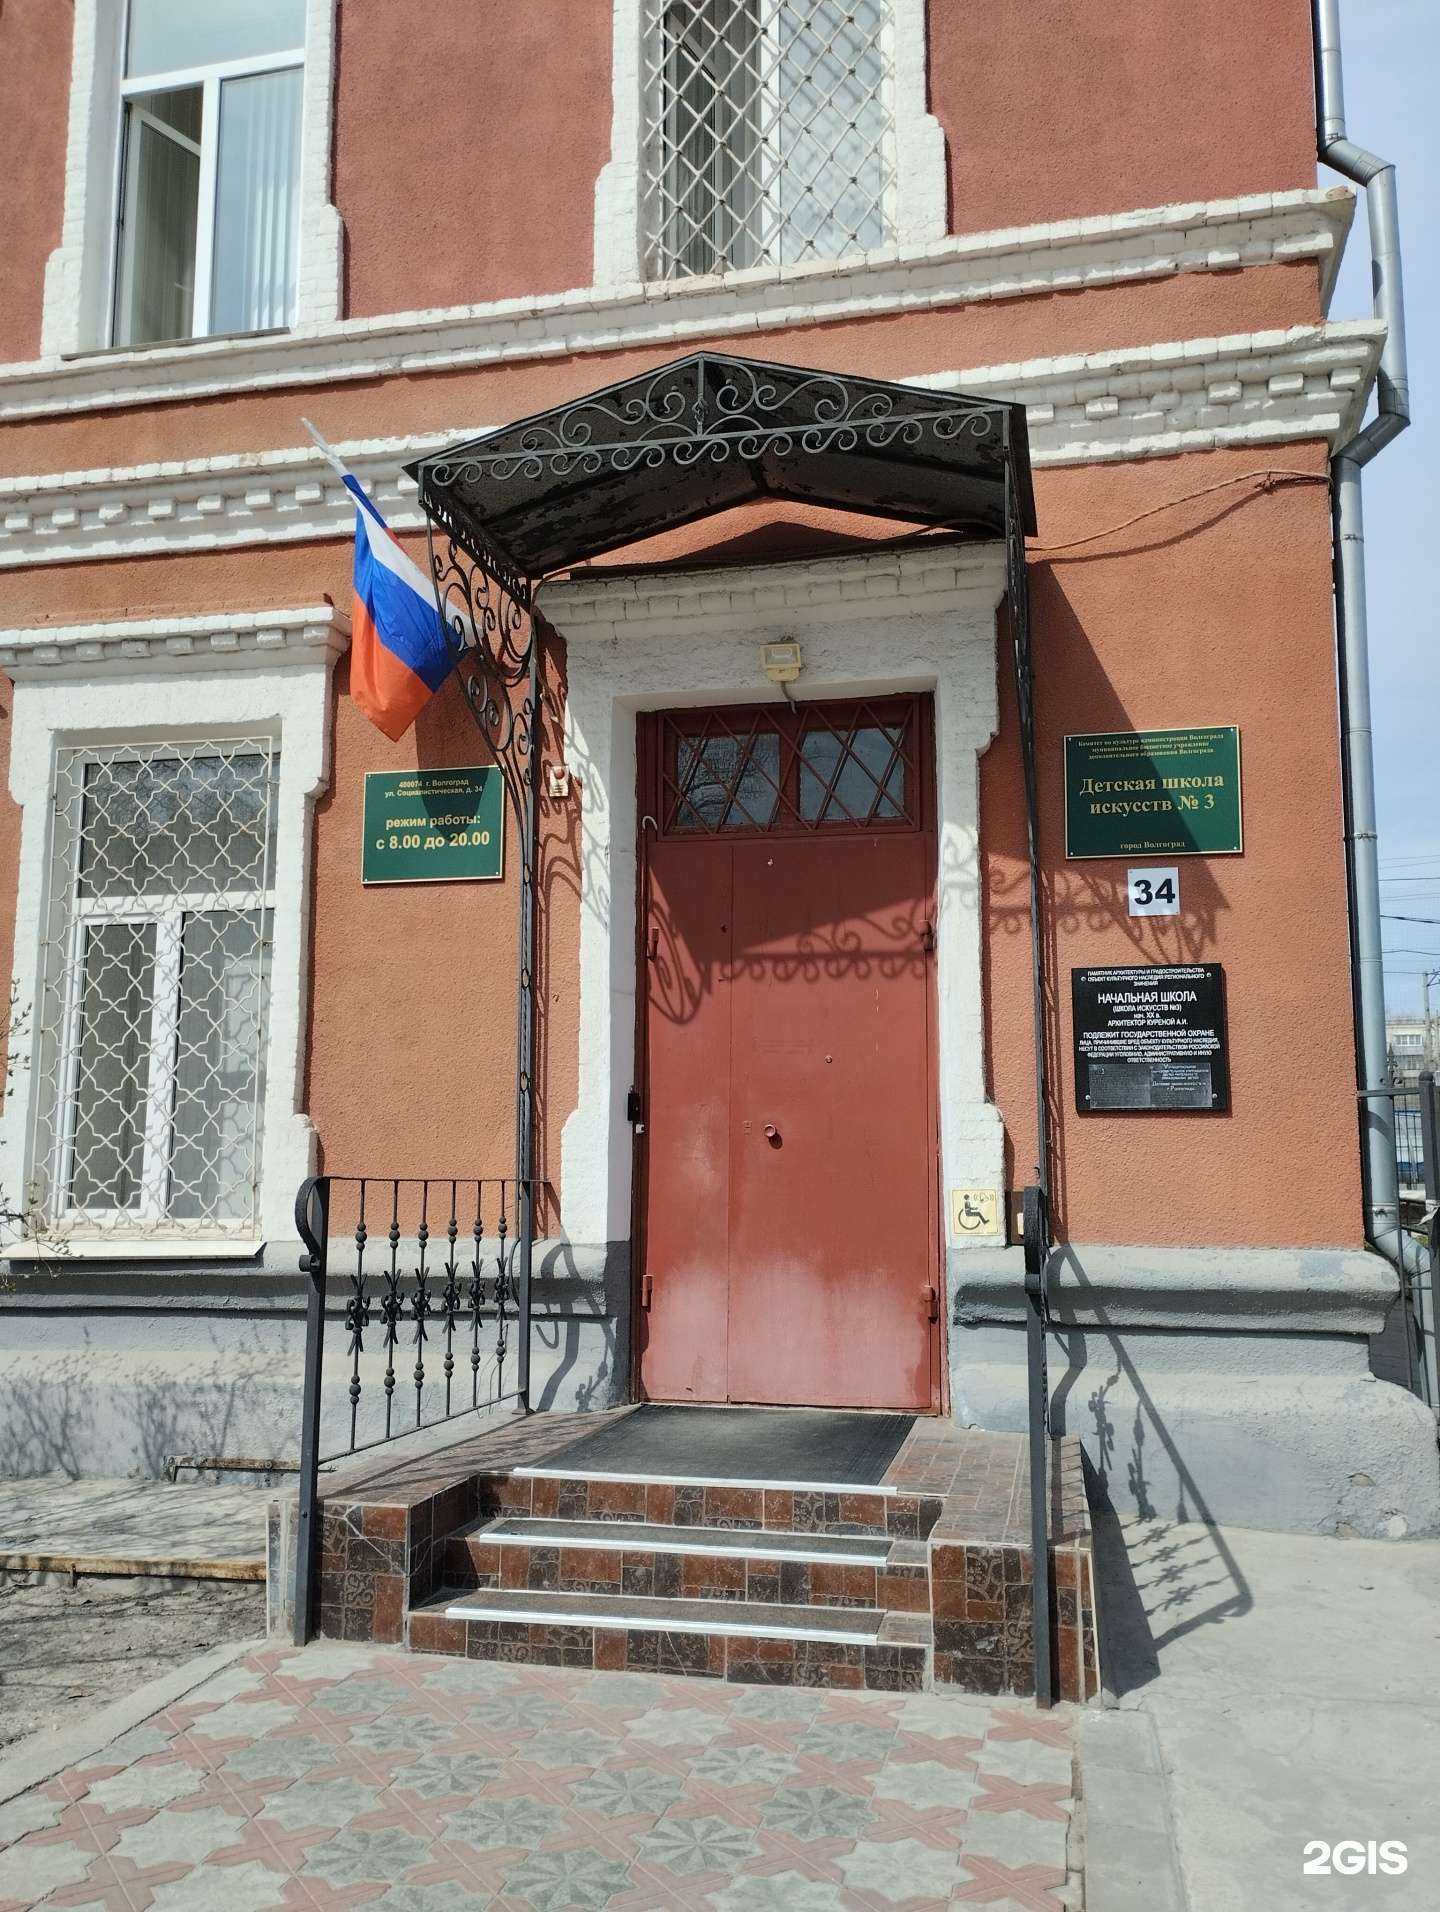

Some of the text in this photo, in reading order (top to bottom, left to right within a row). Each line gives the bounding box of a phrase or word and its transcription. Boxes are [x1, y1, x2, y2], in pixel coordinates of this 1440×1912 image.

[432, 779, 469, 787] Волгоград
[1079, 775, 1224, 796] Детская школа
[385, 791, 395, 799] ул.
[1090, 794, 1215, 817] искусств № 3
[385, 814, 481, 830] режим работы:
[376, 831, 490, 850] с 8.00 до 20.00
[1120, 841, 1185, 851] город Волгоград
[1134, 878, 1176, 905] 34
[1097, 990, 1197, 1004] НАЧАЛЬНАЯ ШКОЛА
[1107, 1019, 1146, 1027] АРХИТЕКТОР
[1083, 1029, 1215, 1039] ПОДЛЕЖИТ ГОСУДАРСТВЕННОЙ ОХРАНЕ
